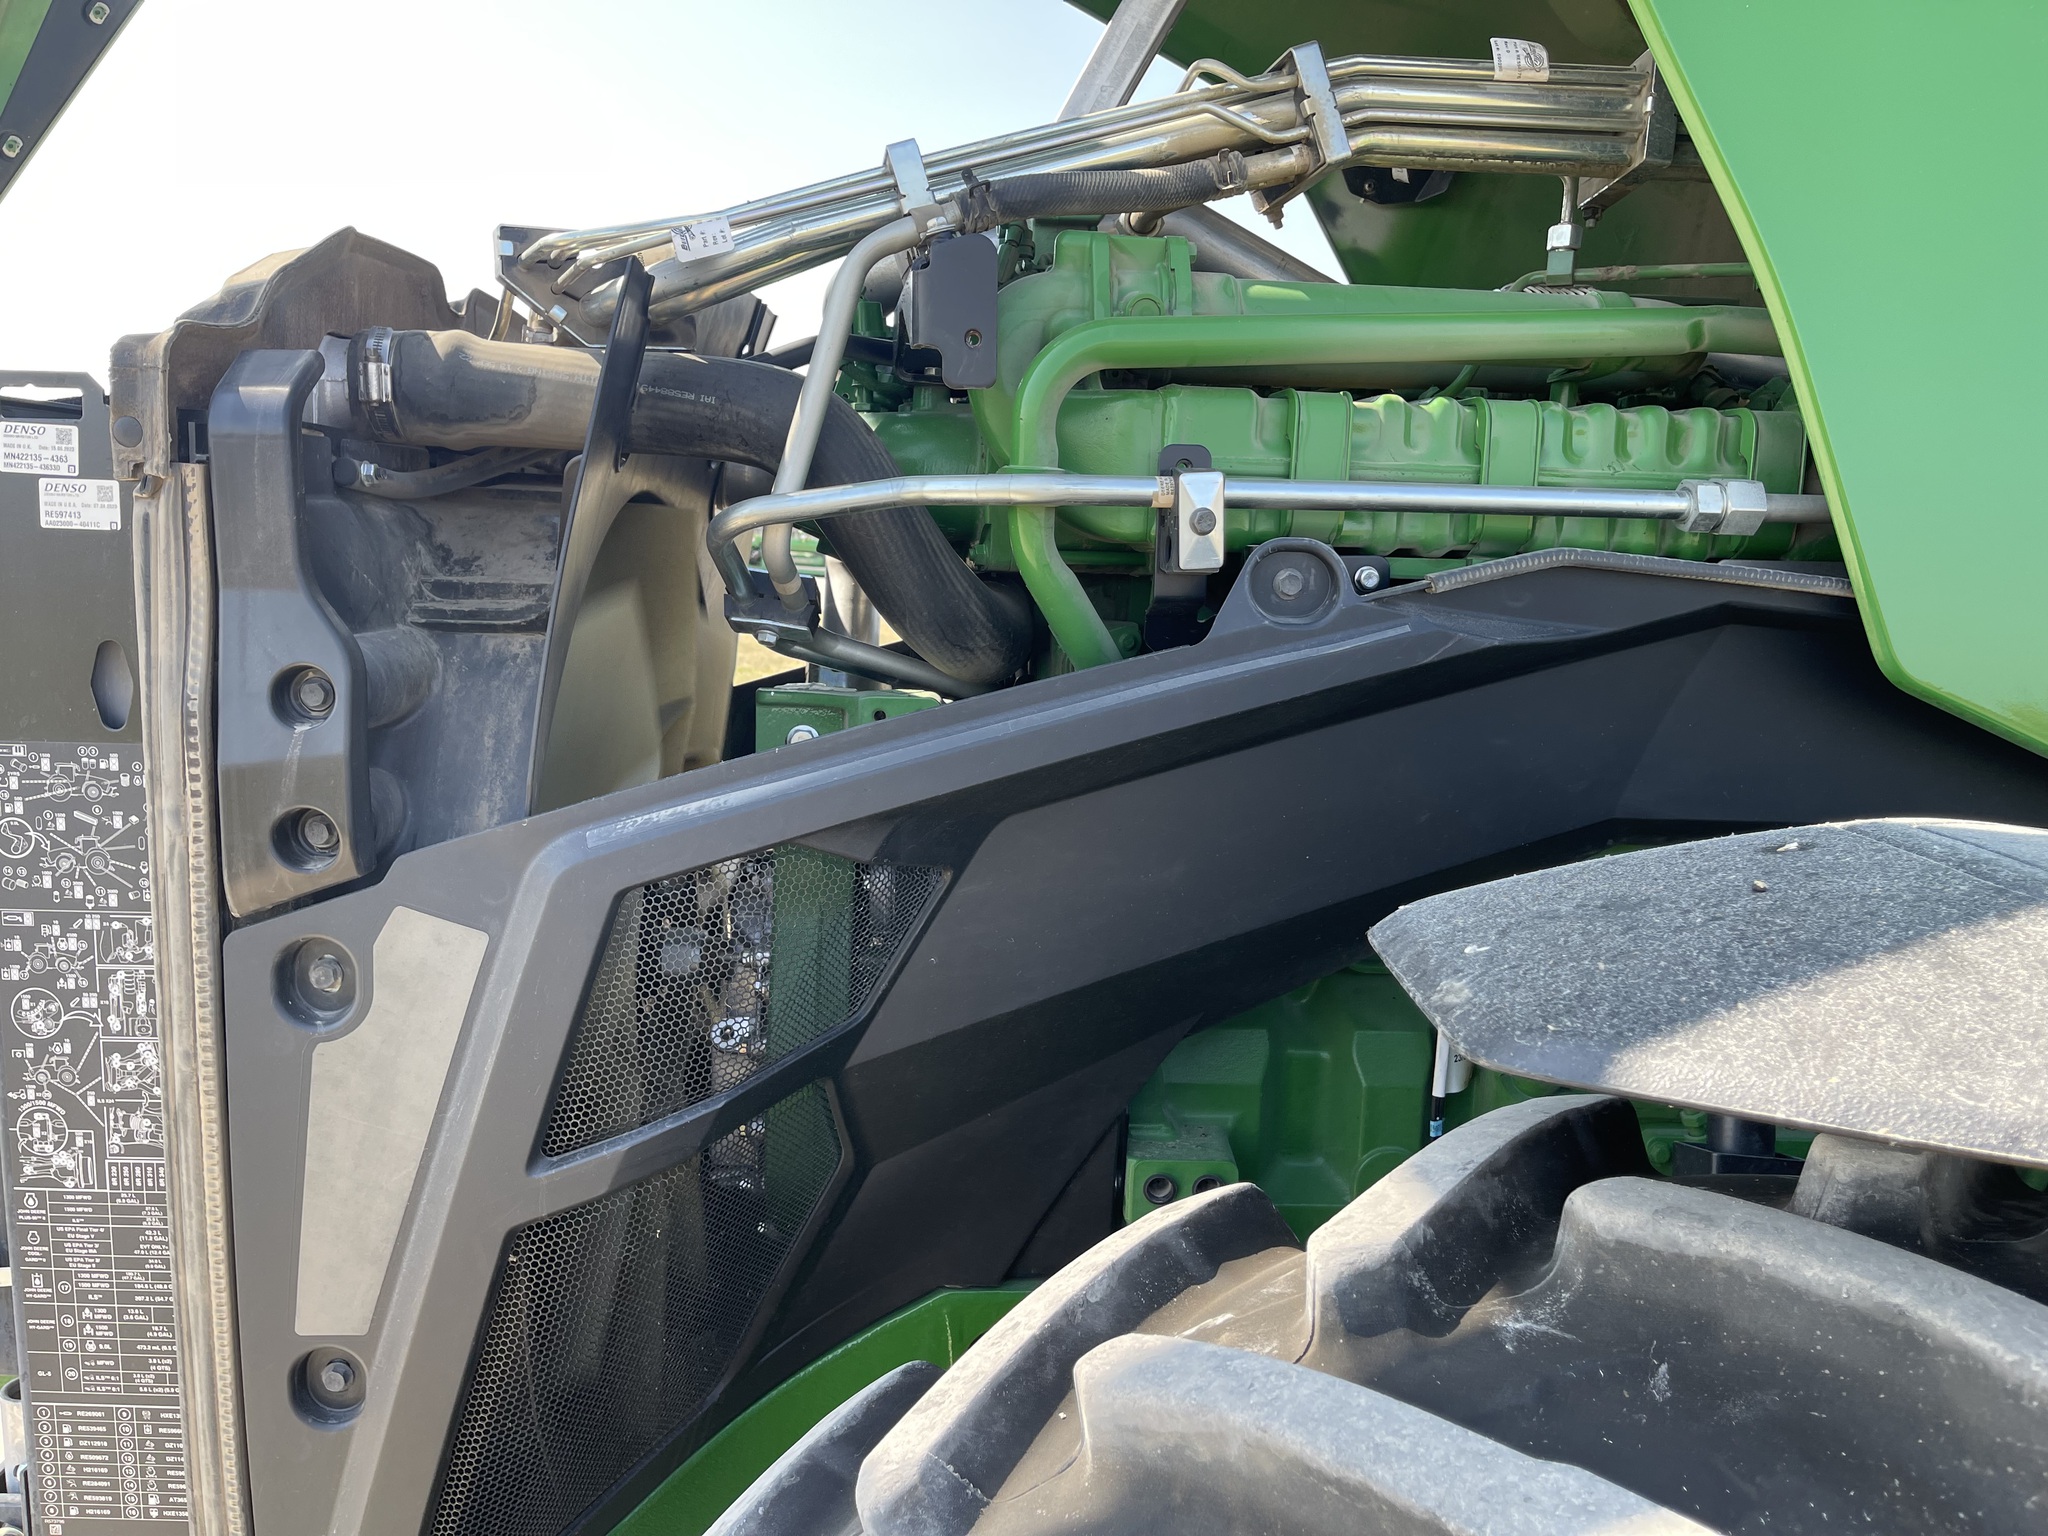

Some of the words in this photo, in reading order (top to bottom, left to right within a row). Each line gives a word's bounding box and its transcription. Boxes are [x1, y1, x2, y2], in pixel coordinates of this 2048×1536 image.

[700, 395, 716, 404] IAI
[4, 425, 46, 435] DENSO
[45, 483, 86, 493] DENSO
[45, 511, 81, 519] RE597413
